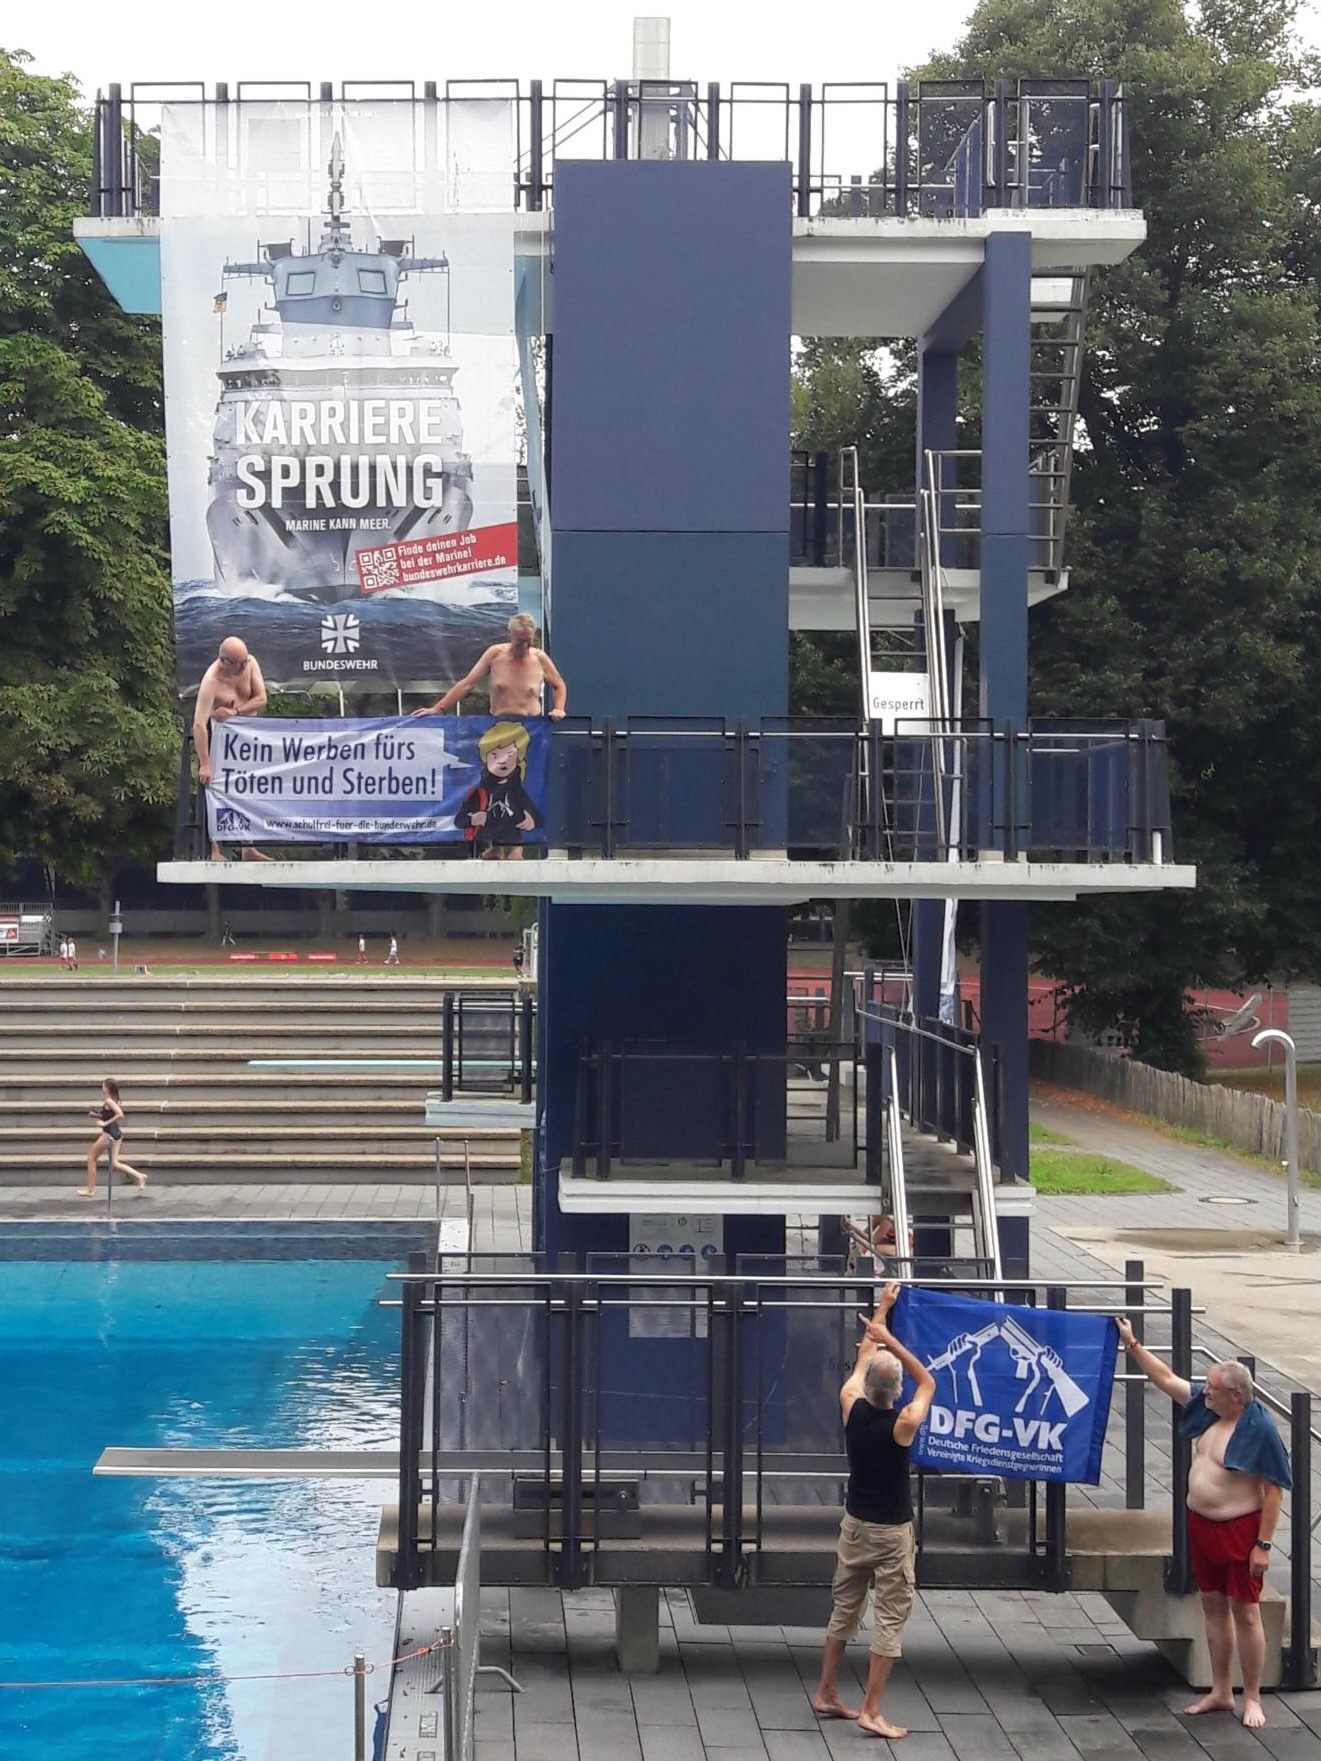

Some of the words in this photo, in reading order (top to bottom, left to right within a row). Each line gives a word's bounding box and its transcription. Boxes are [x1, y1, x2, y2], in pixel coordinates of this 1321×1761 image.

[235, 400, 442, 446] KARRIERE
[235, 454, 444, 509] SPRUNG
[285, 519, 327, 532] MARINE
[329, 518, 357, 530] KANN
[360, 518, 392, 530] MEER.
[398, 543, 424, 557] Finde
[426, 538, 457, 552] deinen
[460, 533, 477, 547] Job
[400, 557, 415, 570] bei
[417, 554, 433, 567] der
[436, 547, 472, 564] Marine!
[402, 555, 506, 582] bundeswehrkarriere.de
[303, 659, 378, 671] BUNDESWEHR
[223, 733, 274, 762] Kein
[282, 734, 366, 762] Werben
[375, 733, 416, 761] fürs
[221, 767, 283, 795] Töten
[293, 766, 334, 795] und
[342, 767, 437, 795] Sterben!
[930, 1404, 1067, 1451] DFG-VK
[927, 1447, 966, 1463] Vereinigte
[928, 1435, 970, 1451] Deutsche
[971, 1443, 1064, 1463] Friedensgesellschaft
